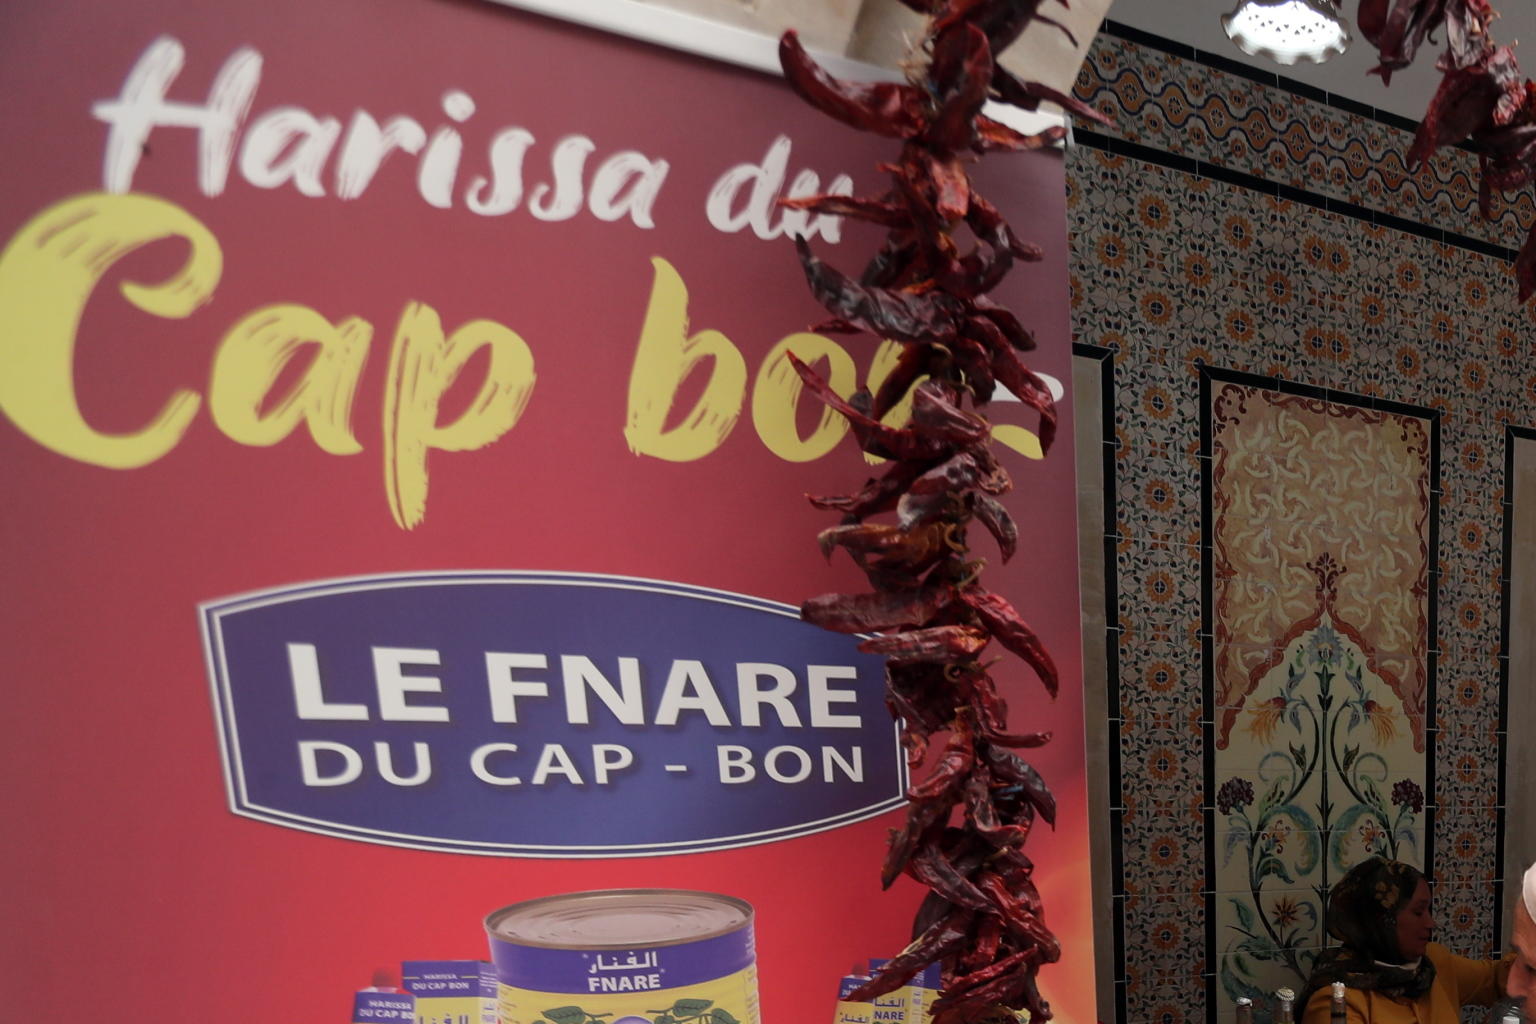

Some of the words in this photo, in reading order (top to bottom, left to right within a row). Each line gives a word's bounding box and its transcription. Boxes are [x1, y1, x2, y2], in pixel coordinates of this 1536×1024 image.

[92, 34, 668, 229] Harissa
[704, 133, 855, 243] du
[0, 192, 537, 531] Cap
[286, 642, 451, 724] LE
[483, 649, 863, 730] FNARE
[298, 740, 433, 788] DU
[470, 742, 634, 786] CAP
[717, 744, 865, 784] BON
[589, 951, 657, 974] الفنار
[412, 982, 427, 990] DU
[429, 982, 446, 990] CAP
[449, 981, 469, 990] BON
[588, 974, 661, 992] FNARE
[359, 1008, 373, 1017] DU
[376, 1009, 398, 1018] CAP
[401, 1010, 415, 1019] BO
[369, 1000, 412, 1010] HARISSA
[875, 1011, 904, 1020] NARE
